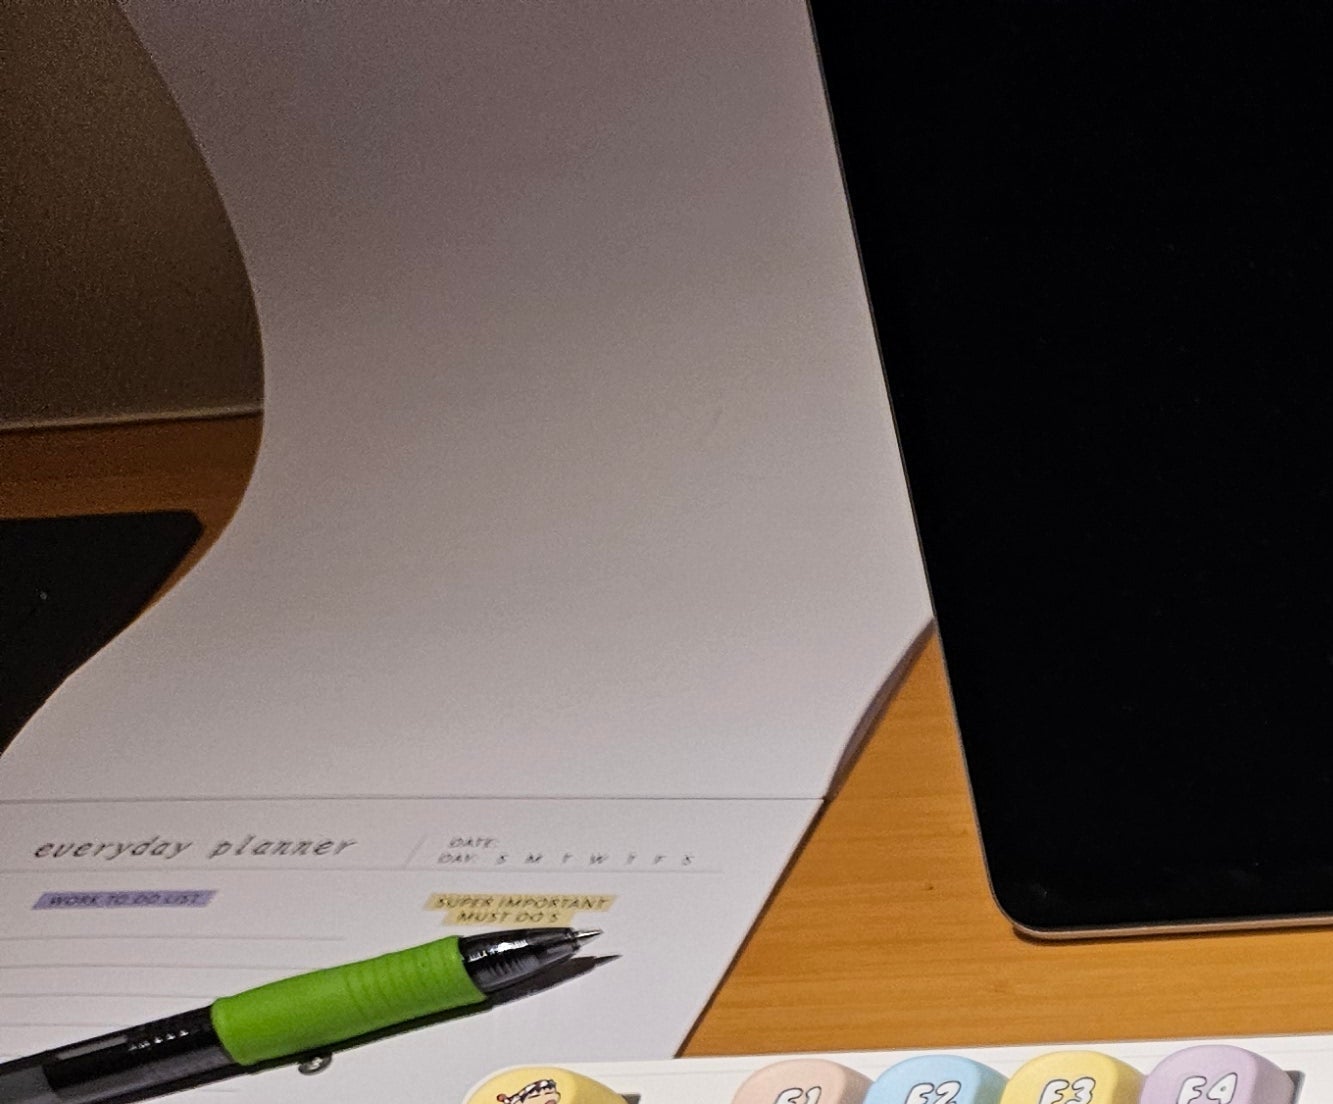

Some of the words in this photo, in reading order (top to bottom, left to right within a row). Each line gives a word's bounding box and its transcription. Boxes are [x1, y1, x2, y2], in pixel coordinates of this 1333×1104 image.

[34, 836, 192, 861] everyday
[208, 835, 357, 859] planner
[435, 897, 493, 909] SUPER
[498, 897, 611, 910] IMPORTANT
[456, 911, 511, 922] MUST
[515, 911, 562, 922] DOS
